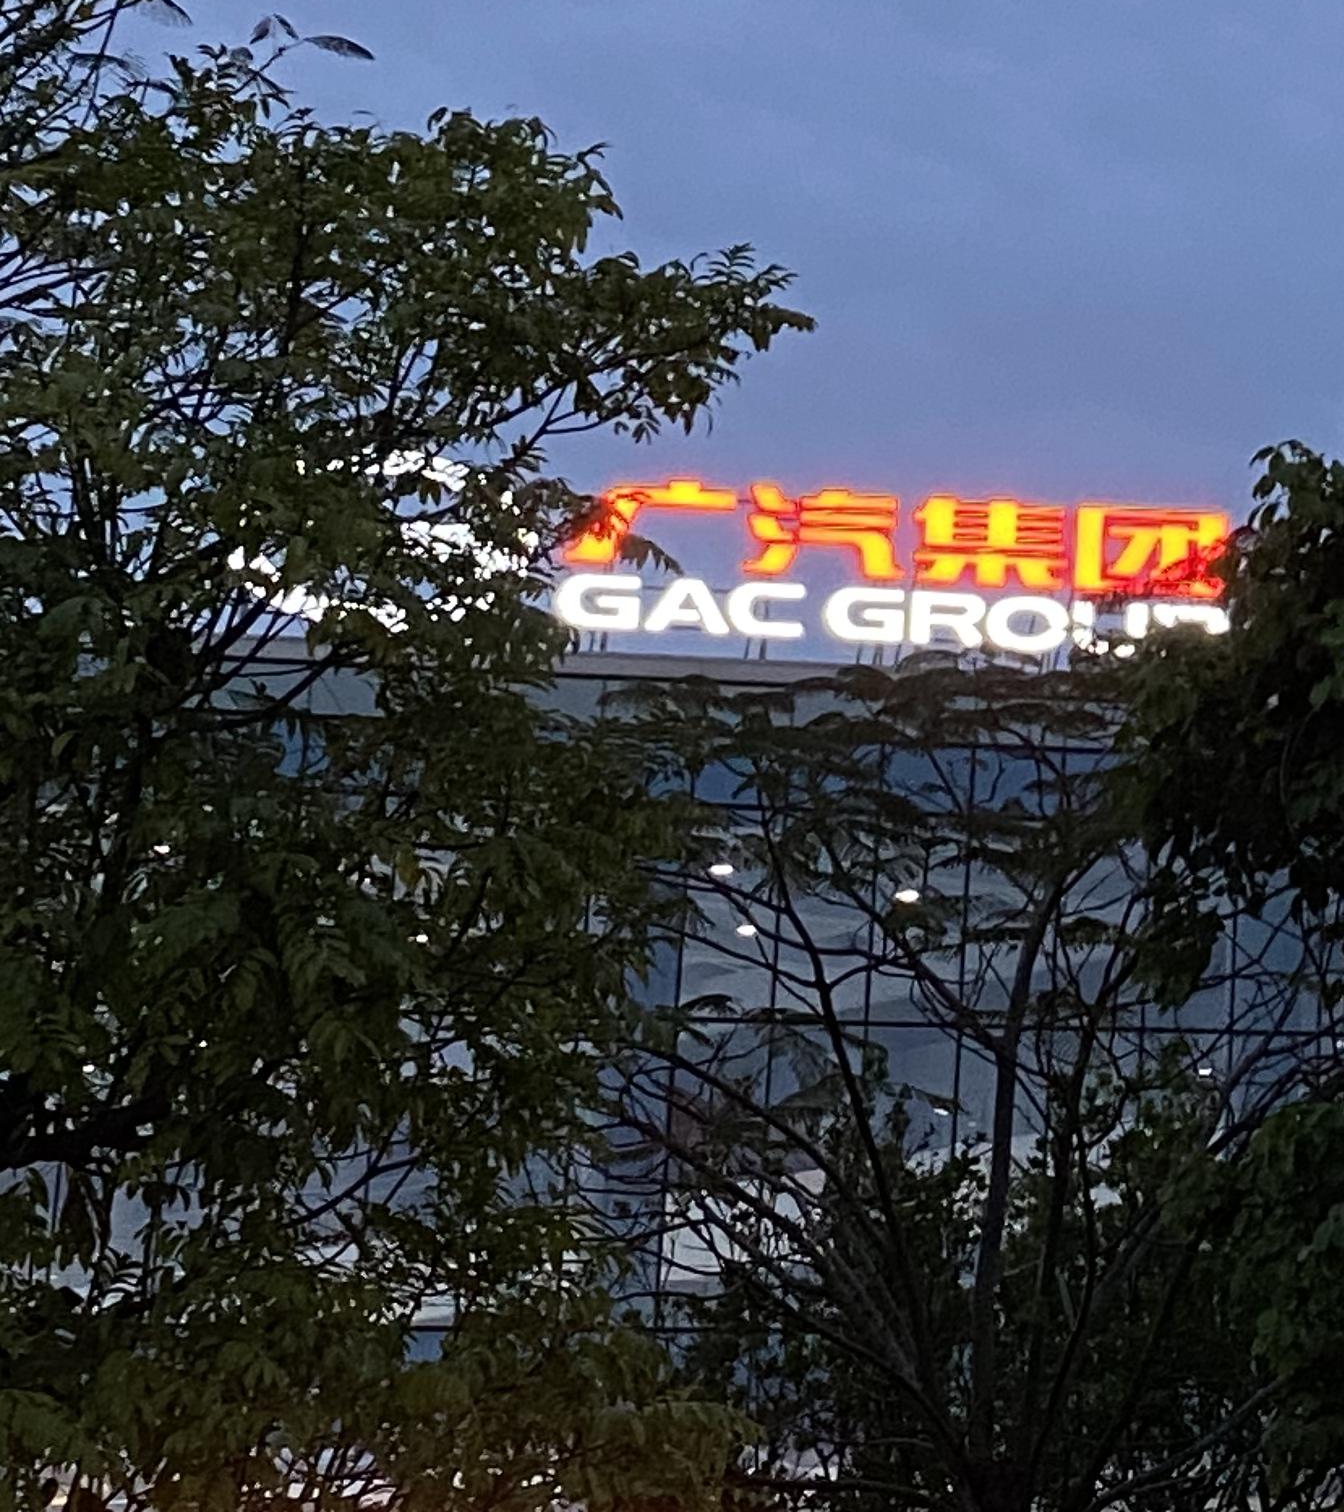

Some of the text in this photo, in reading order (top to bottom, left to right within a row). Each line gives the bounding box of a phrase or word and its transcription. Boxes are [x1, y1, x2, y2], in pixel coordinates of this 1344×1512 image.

[562, 476, 1232, 602] 广汽集团
[554, 573, 807, 639] GAC
